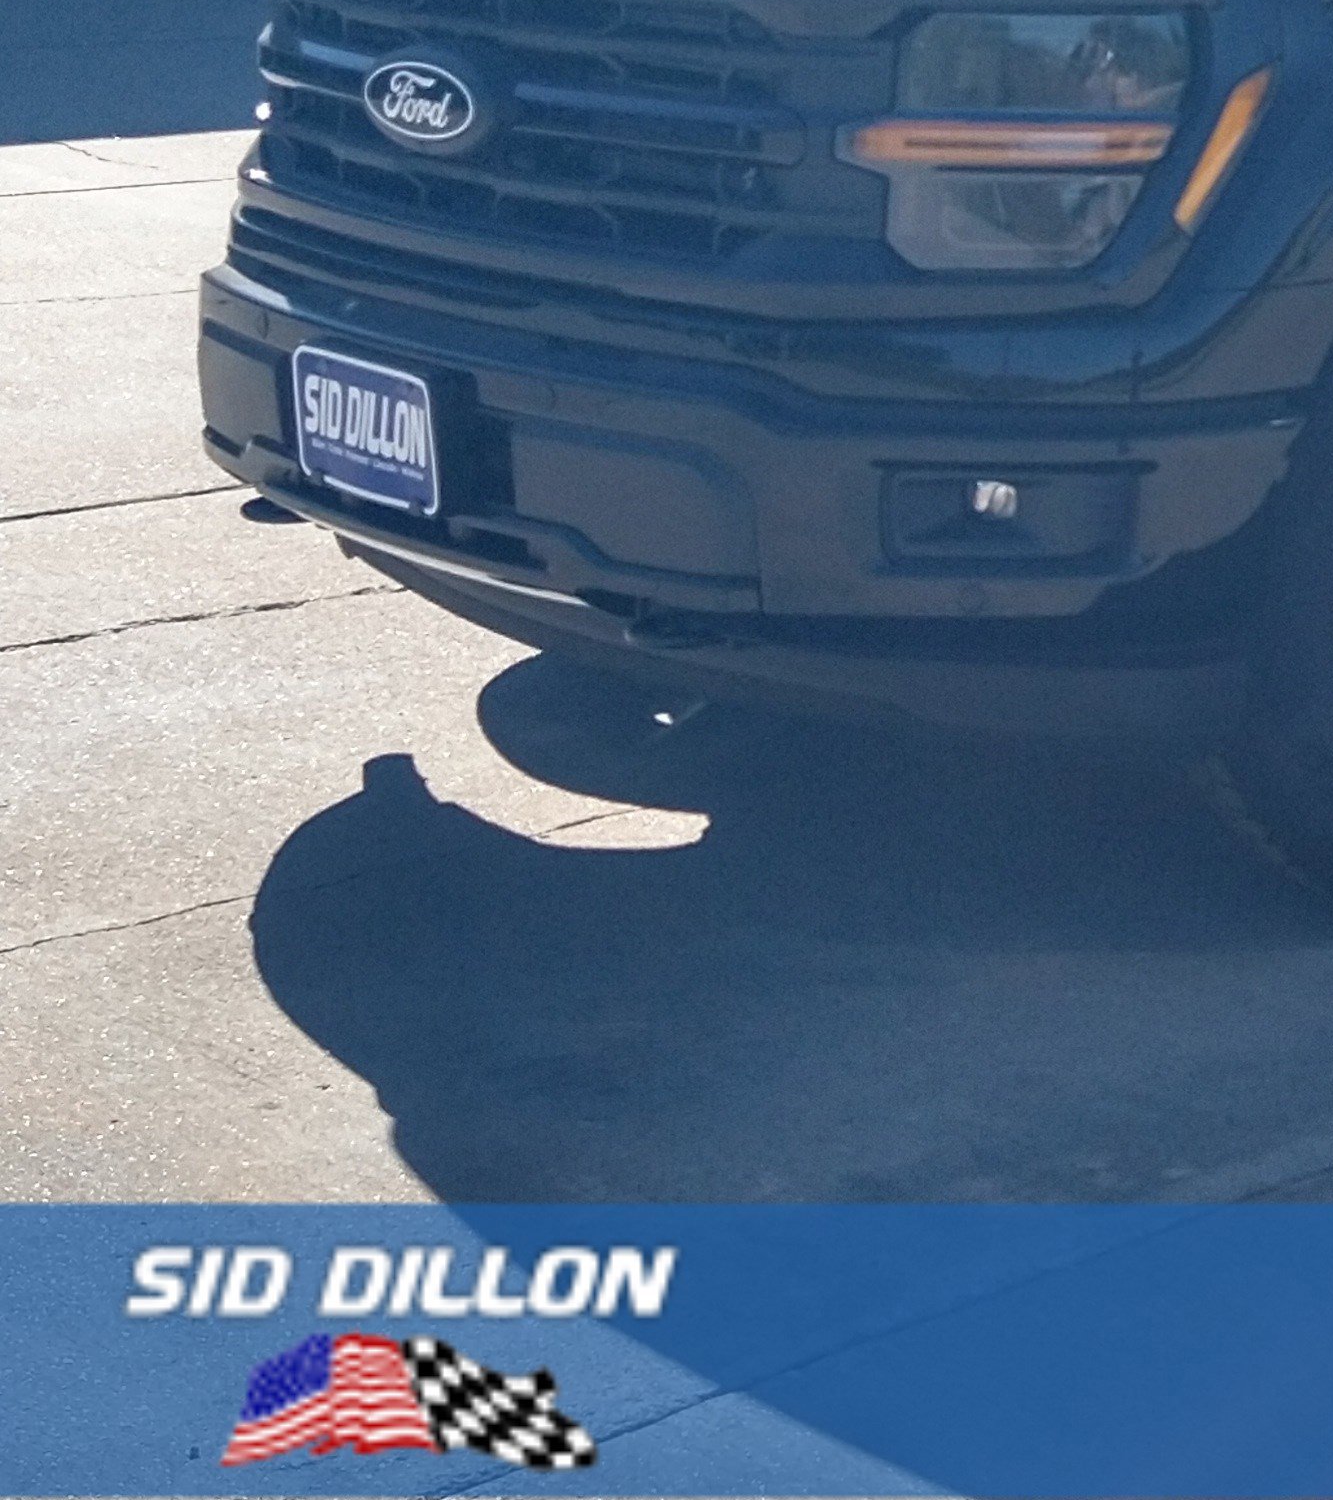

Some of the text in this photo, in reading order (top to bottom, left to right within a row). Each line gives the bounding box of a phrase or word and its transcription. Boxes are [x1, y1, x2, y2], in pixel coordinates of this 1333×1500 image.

[382, 70, 452, 129] Ford
[304, 373, 342, 440] SID
[344, 385, 426, 469] DILLON
